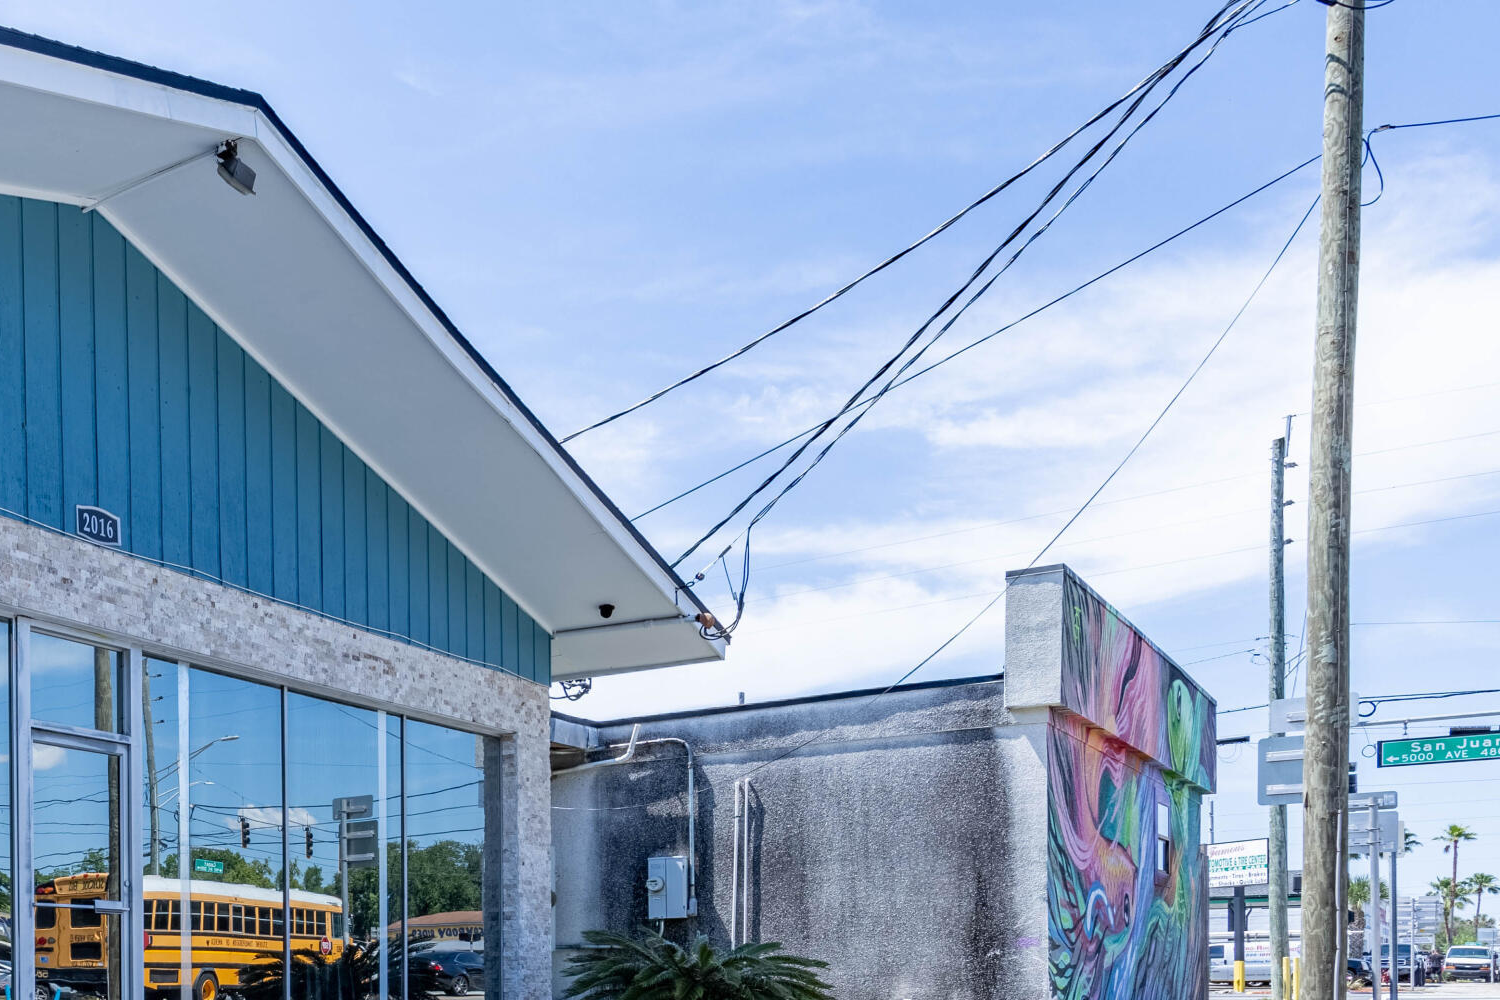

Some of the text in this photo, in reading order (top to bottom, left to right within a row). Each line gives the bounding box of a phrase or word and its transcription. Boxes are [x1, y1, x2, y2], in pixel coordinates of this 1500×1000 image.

[82, 512, 114, 539] 2016
[1411, 742, 1445, 752] San
[1402, 752, 1434, 763] 5000
[1445, 749, 1469, 759] AVE
[1238, 856, 1248, 865] TIRE
[1249, 854, 1267, 865] CENTER
